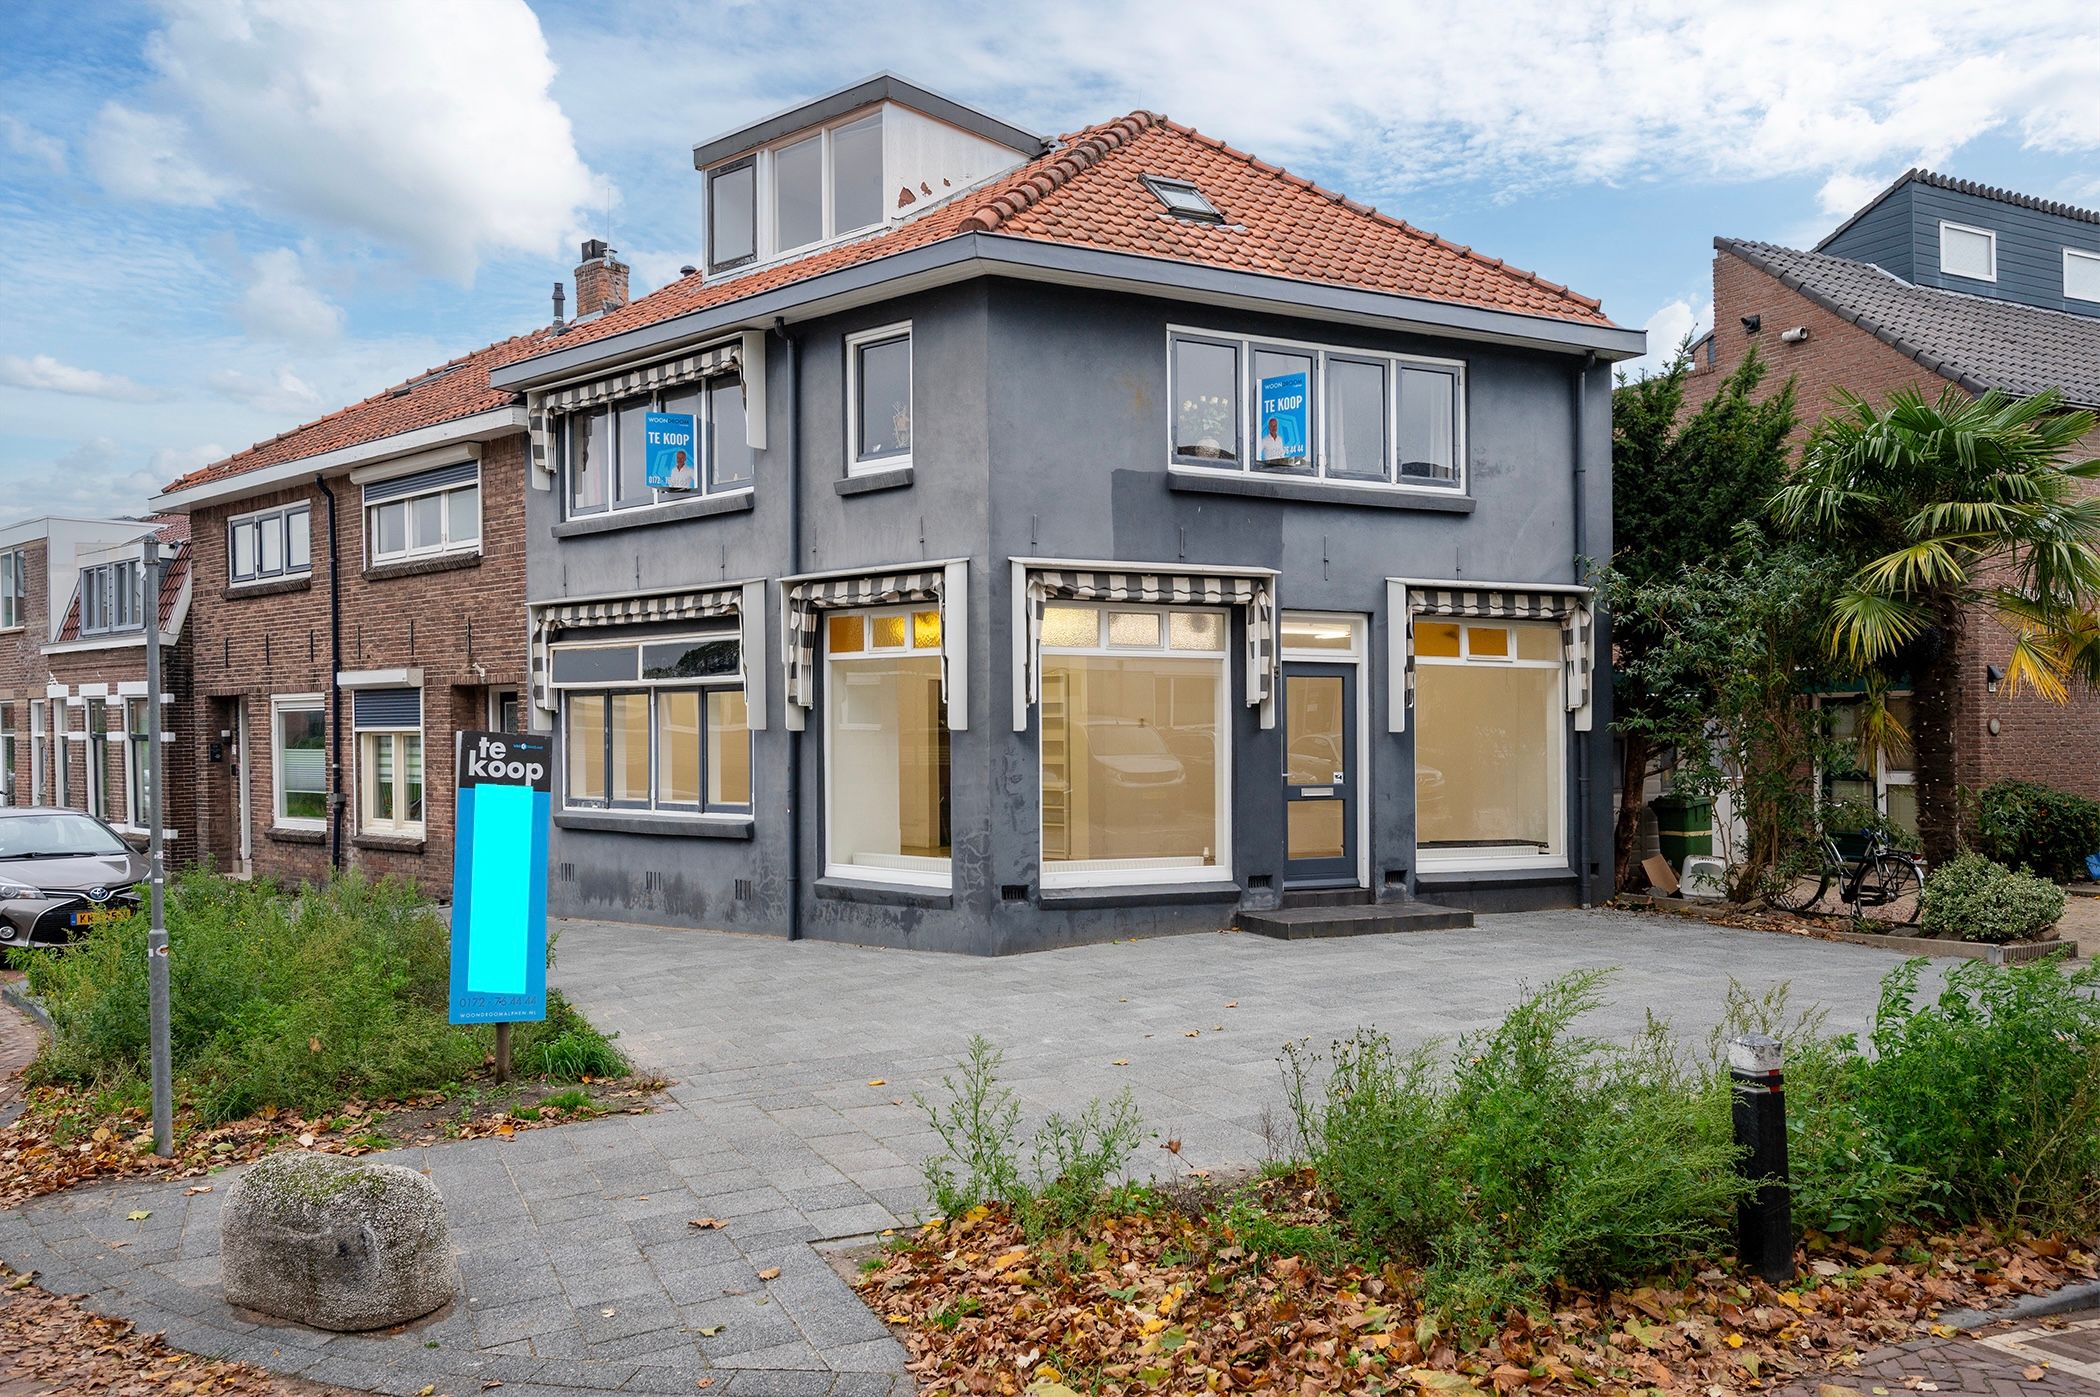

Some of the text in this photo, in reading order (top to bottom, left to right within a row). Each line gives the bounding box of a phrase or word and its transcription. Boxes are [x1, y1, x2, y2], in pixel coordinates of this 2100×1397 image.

[1264, 395, 1303, 413] TE KOOP
[648, 431, 690, 446] TE KOOP
[478, 736, 507, 760] te
[468, 750, 544, 787] koop
[459, 997, 485, 1008] 0172
